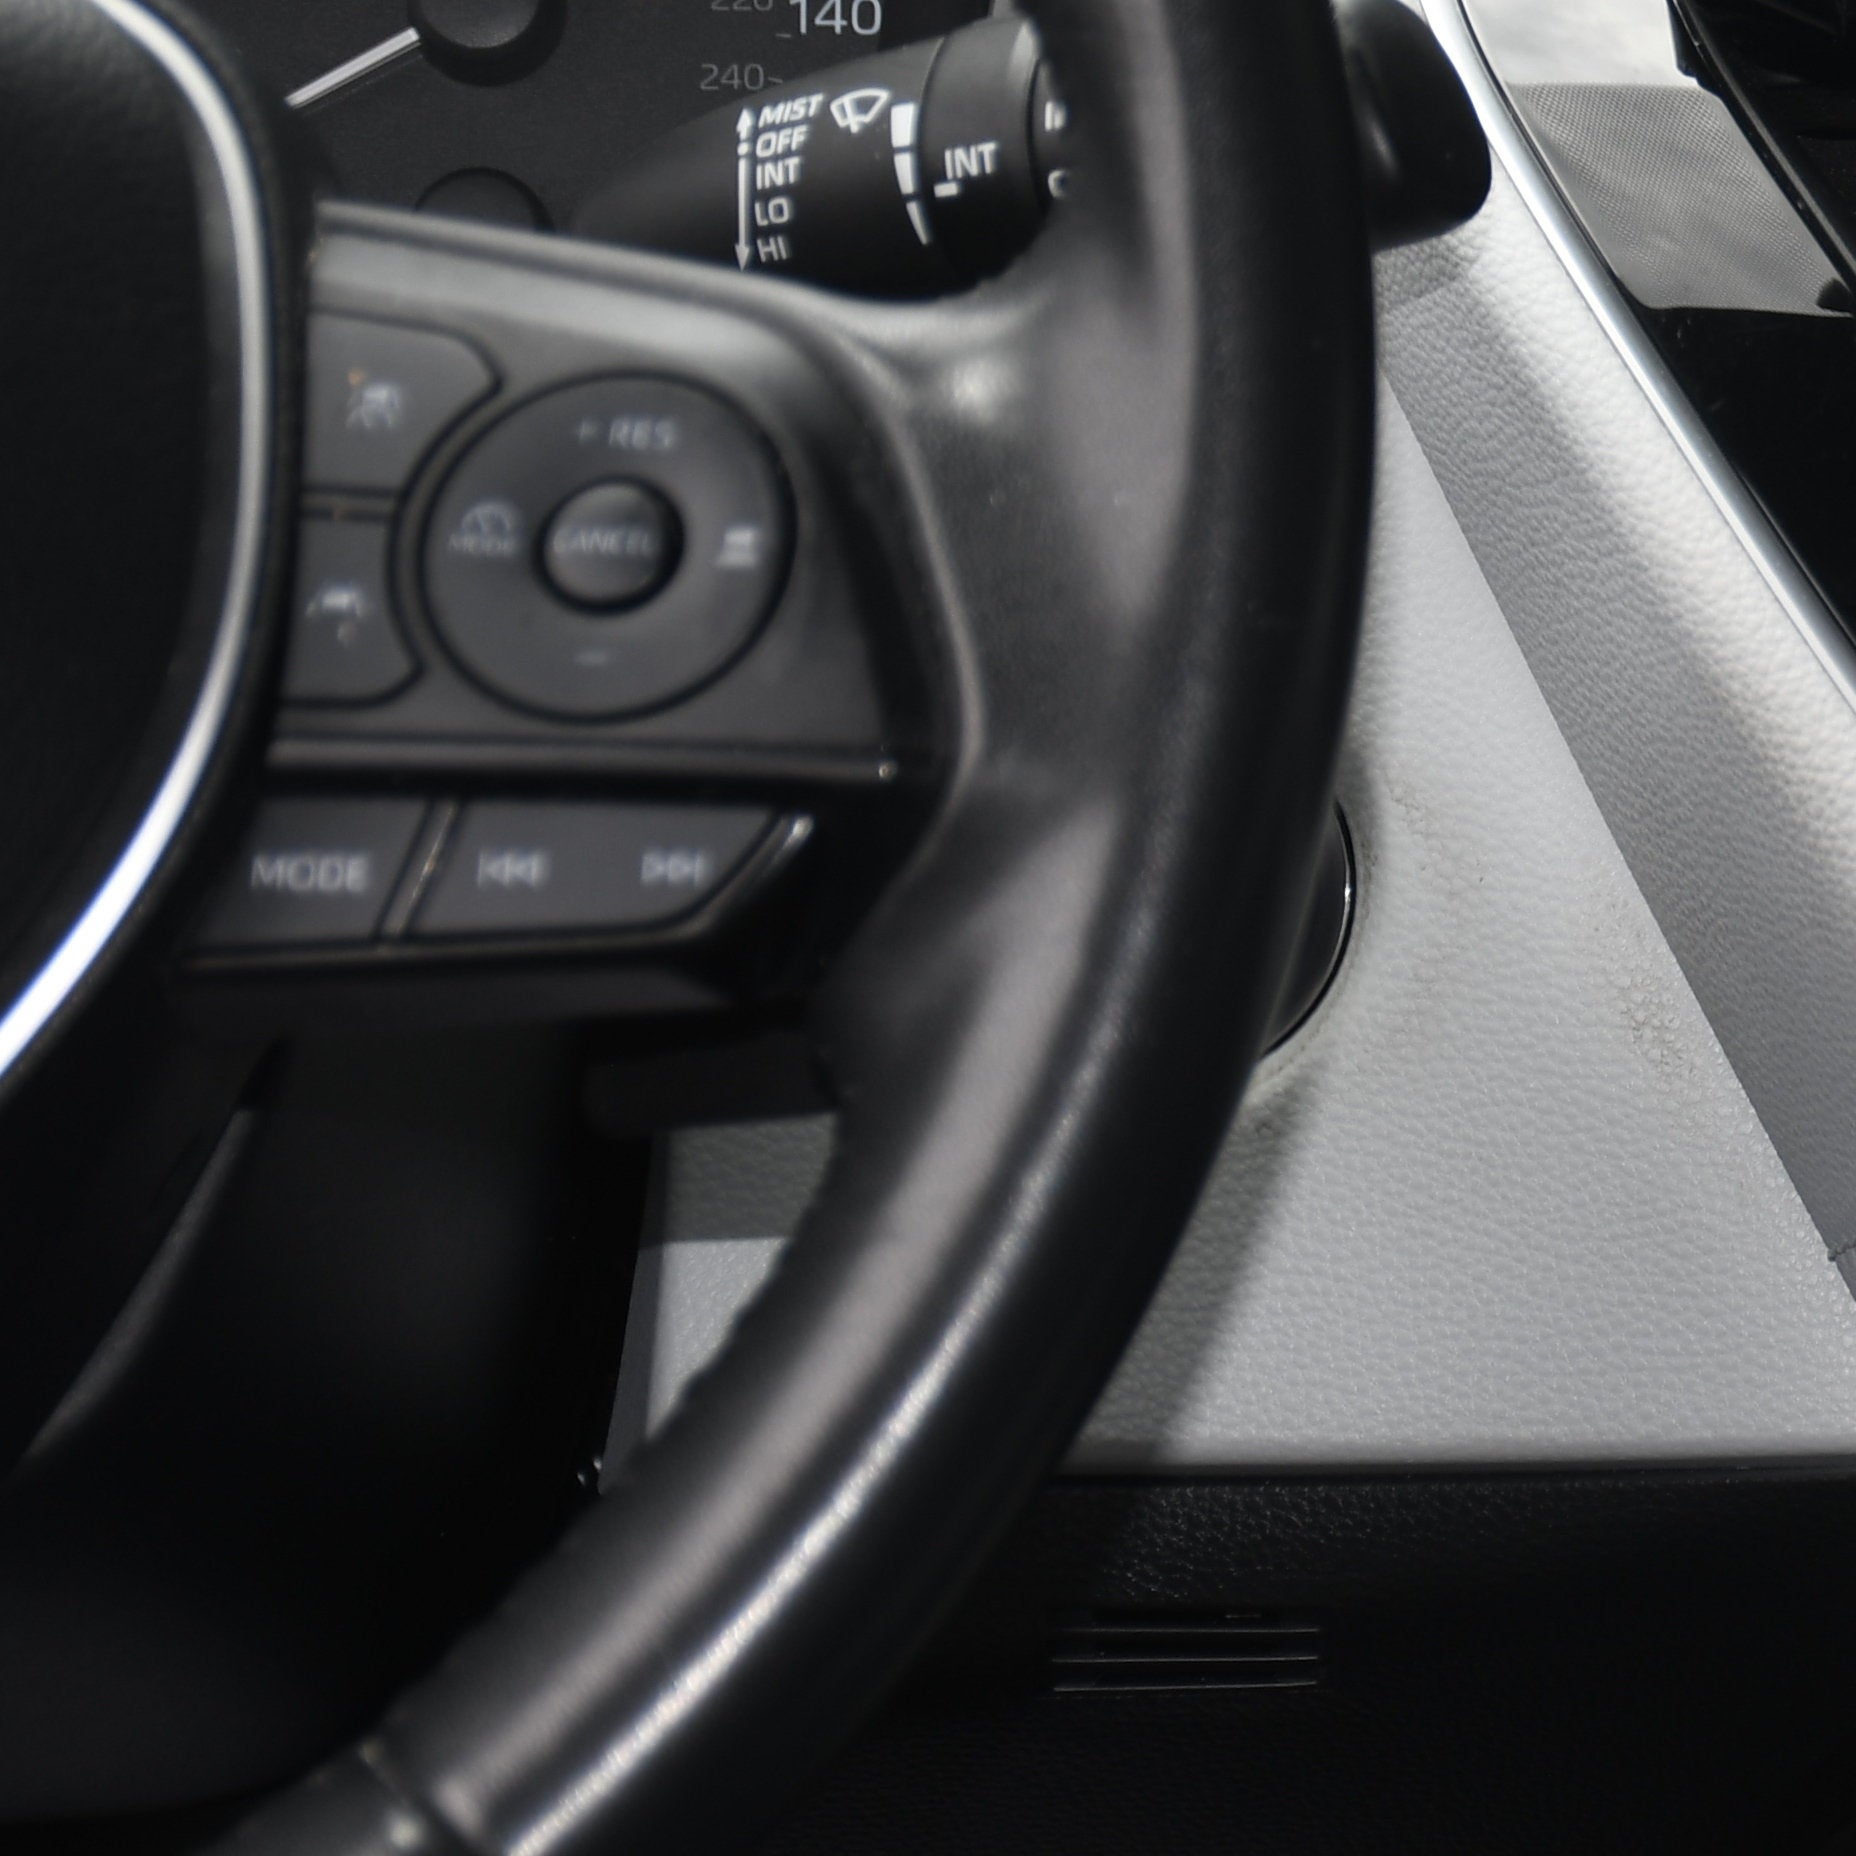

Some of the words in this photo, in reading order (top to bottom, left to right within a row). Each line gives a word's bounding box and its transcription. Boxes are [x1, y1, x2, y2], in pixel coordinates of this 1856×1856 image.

[699, 63, 765, 92] 240
[758, 93, 824, 128] MIST
[755, 125, 809, 159] OFF
[755, 156, 802, 190] INT
[944, 142, 998, 180] INT
[754, 196, 792, 226] LO
[755, 236, 791, 263] HI
[248, 852, 372, 896] MODE
